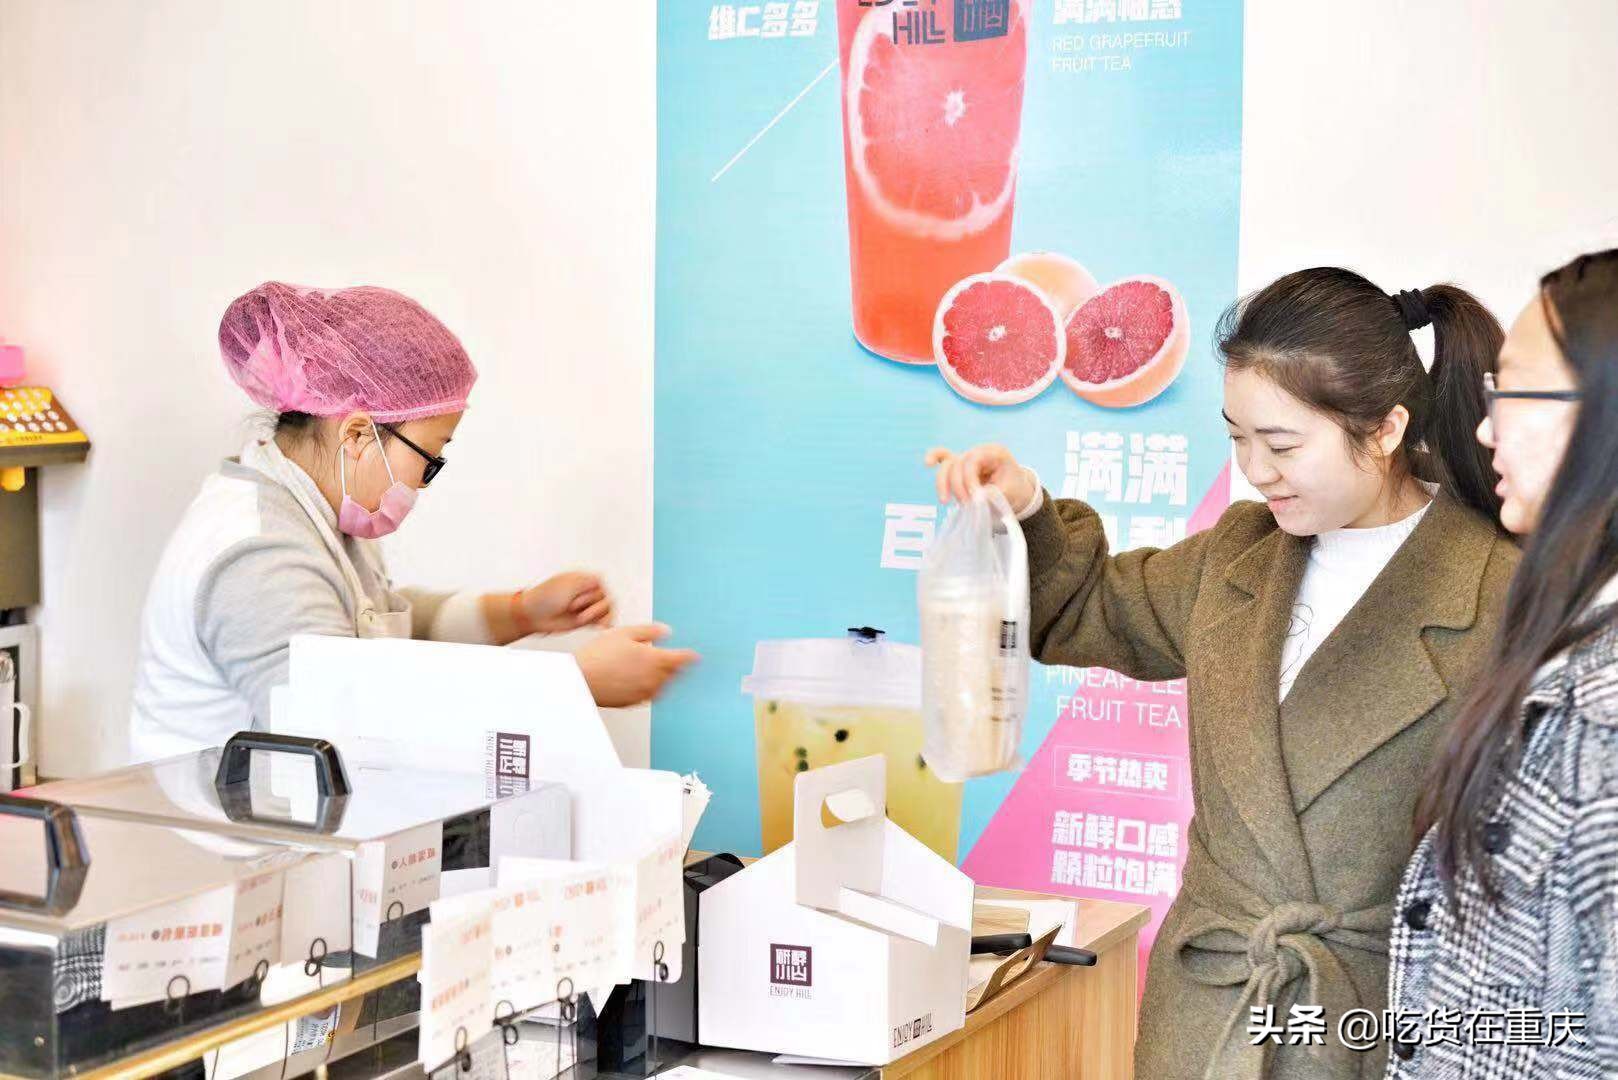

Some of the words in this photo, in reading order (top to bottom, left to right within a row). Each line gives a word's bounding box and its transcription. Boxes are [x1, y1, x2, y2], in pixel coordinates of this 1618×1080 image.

[893, 10, 945, 45] HILL
[1052, 36, 1084, 51] RED
[1089, 31, 1191, 49] GRAPEFRUIT
[1052, 57, 1098, 72] FRUIT
[1102, 56, 1132, 70] TEA
[1061, 431, 1189, 505] 满满
[1056, 696, 1125, 721] FRUIT
[1134, 702, 1182, 728] TEA
[1066, 754, 1169, 791] 季节热卖
[1051, 810, 1180, 857] 新鲜口感
[1051, 850, 1178, 898] 颗粒饱满
[770, 985, 794, 998] ENJOY
[893, 1021, 913, 1048] ENJOY
[921, 1012, 933, 1037] HILL
